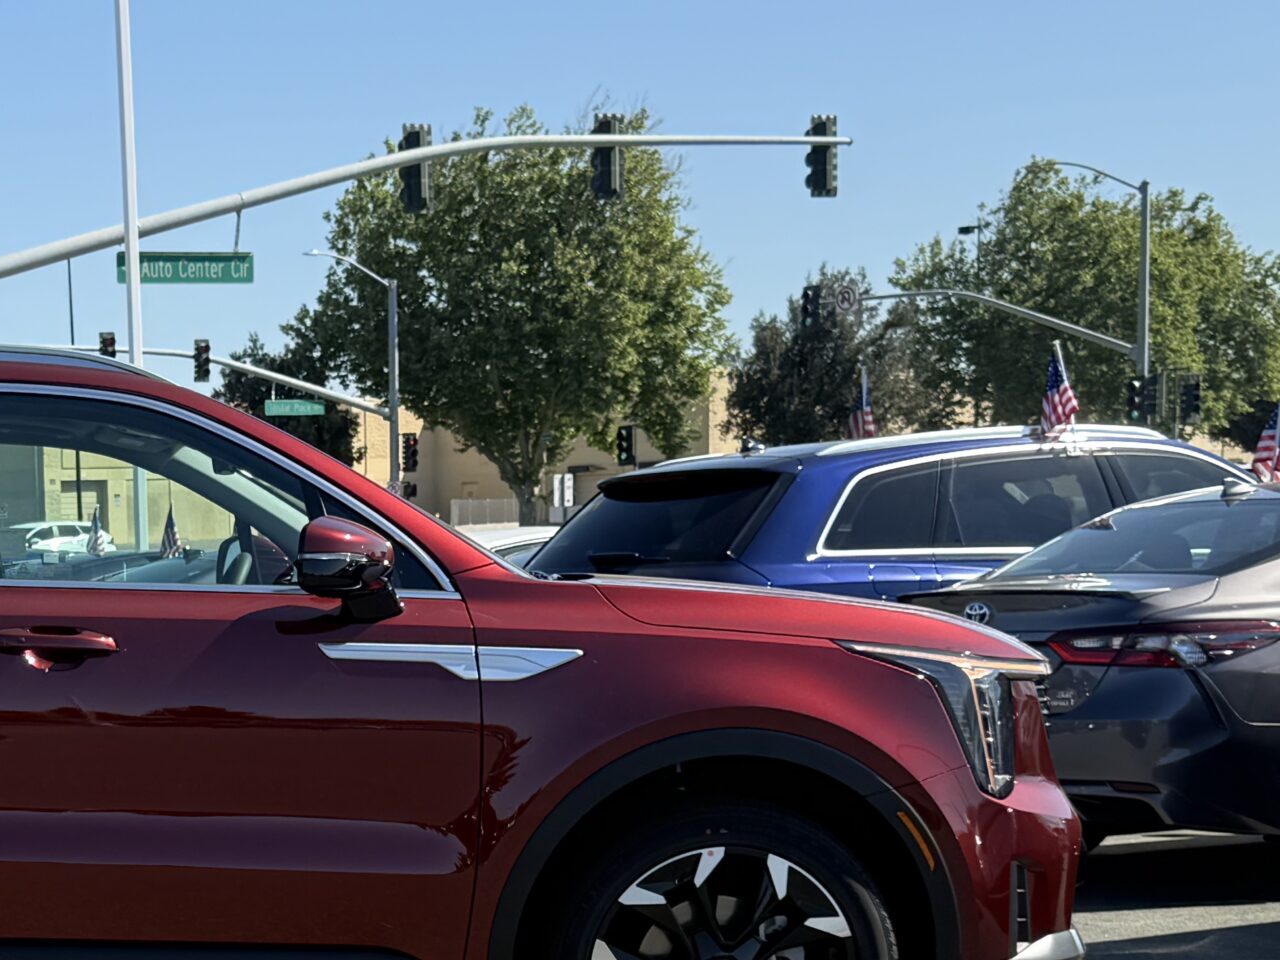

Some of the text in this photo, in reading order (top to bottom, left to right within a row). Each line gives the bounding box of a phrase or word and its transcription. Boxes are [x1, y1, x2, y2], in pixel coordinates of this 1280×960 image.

[141, 259, 250, 278] Auto Center Cir
